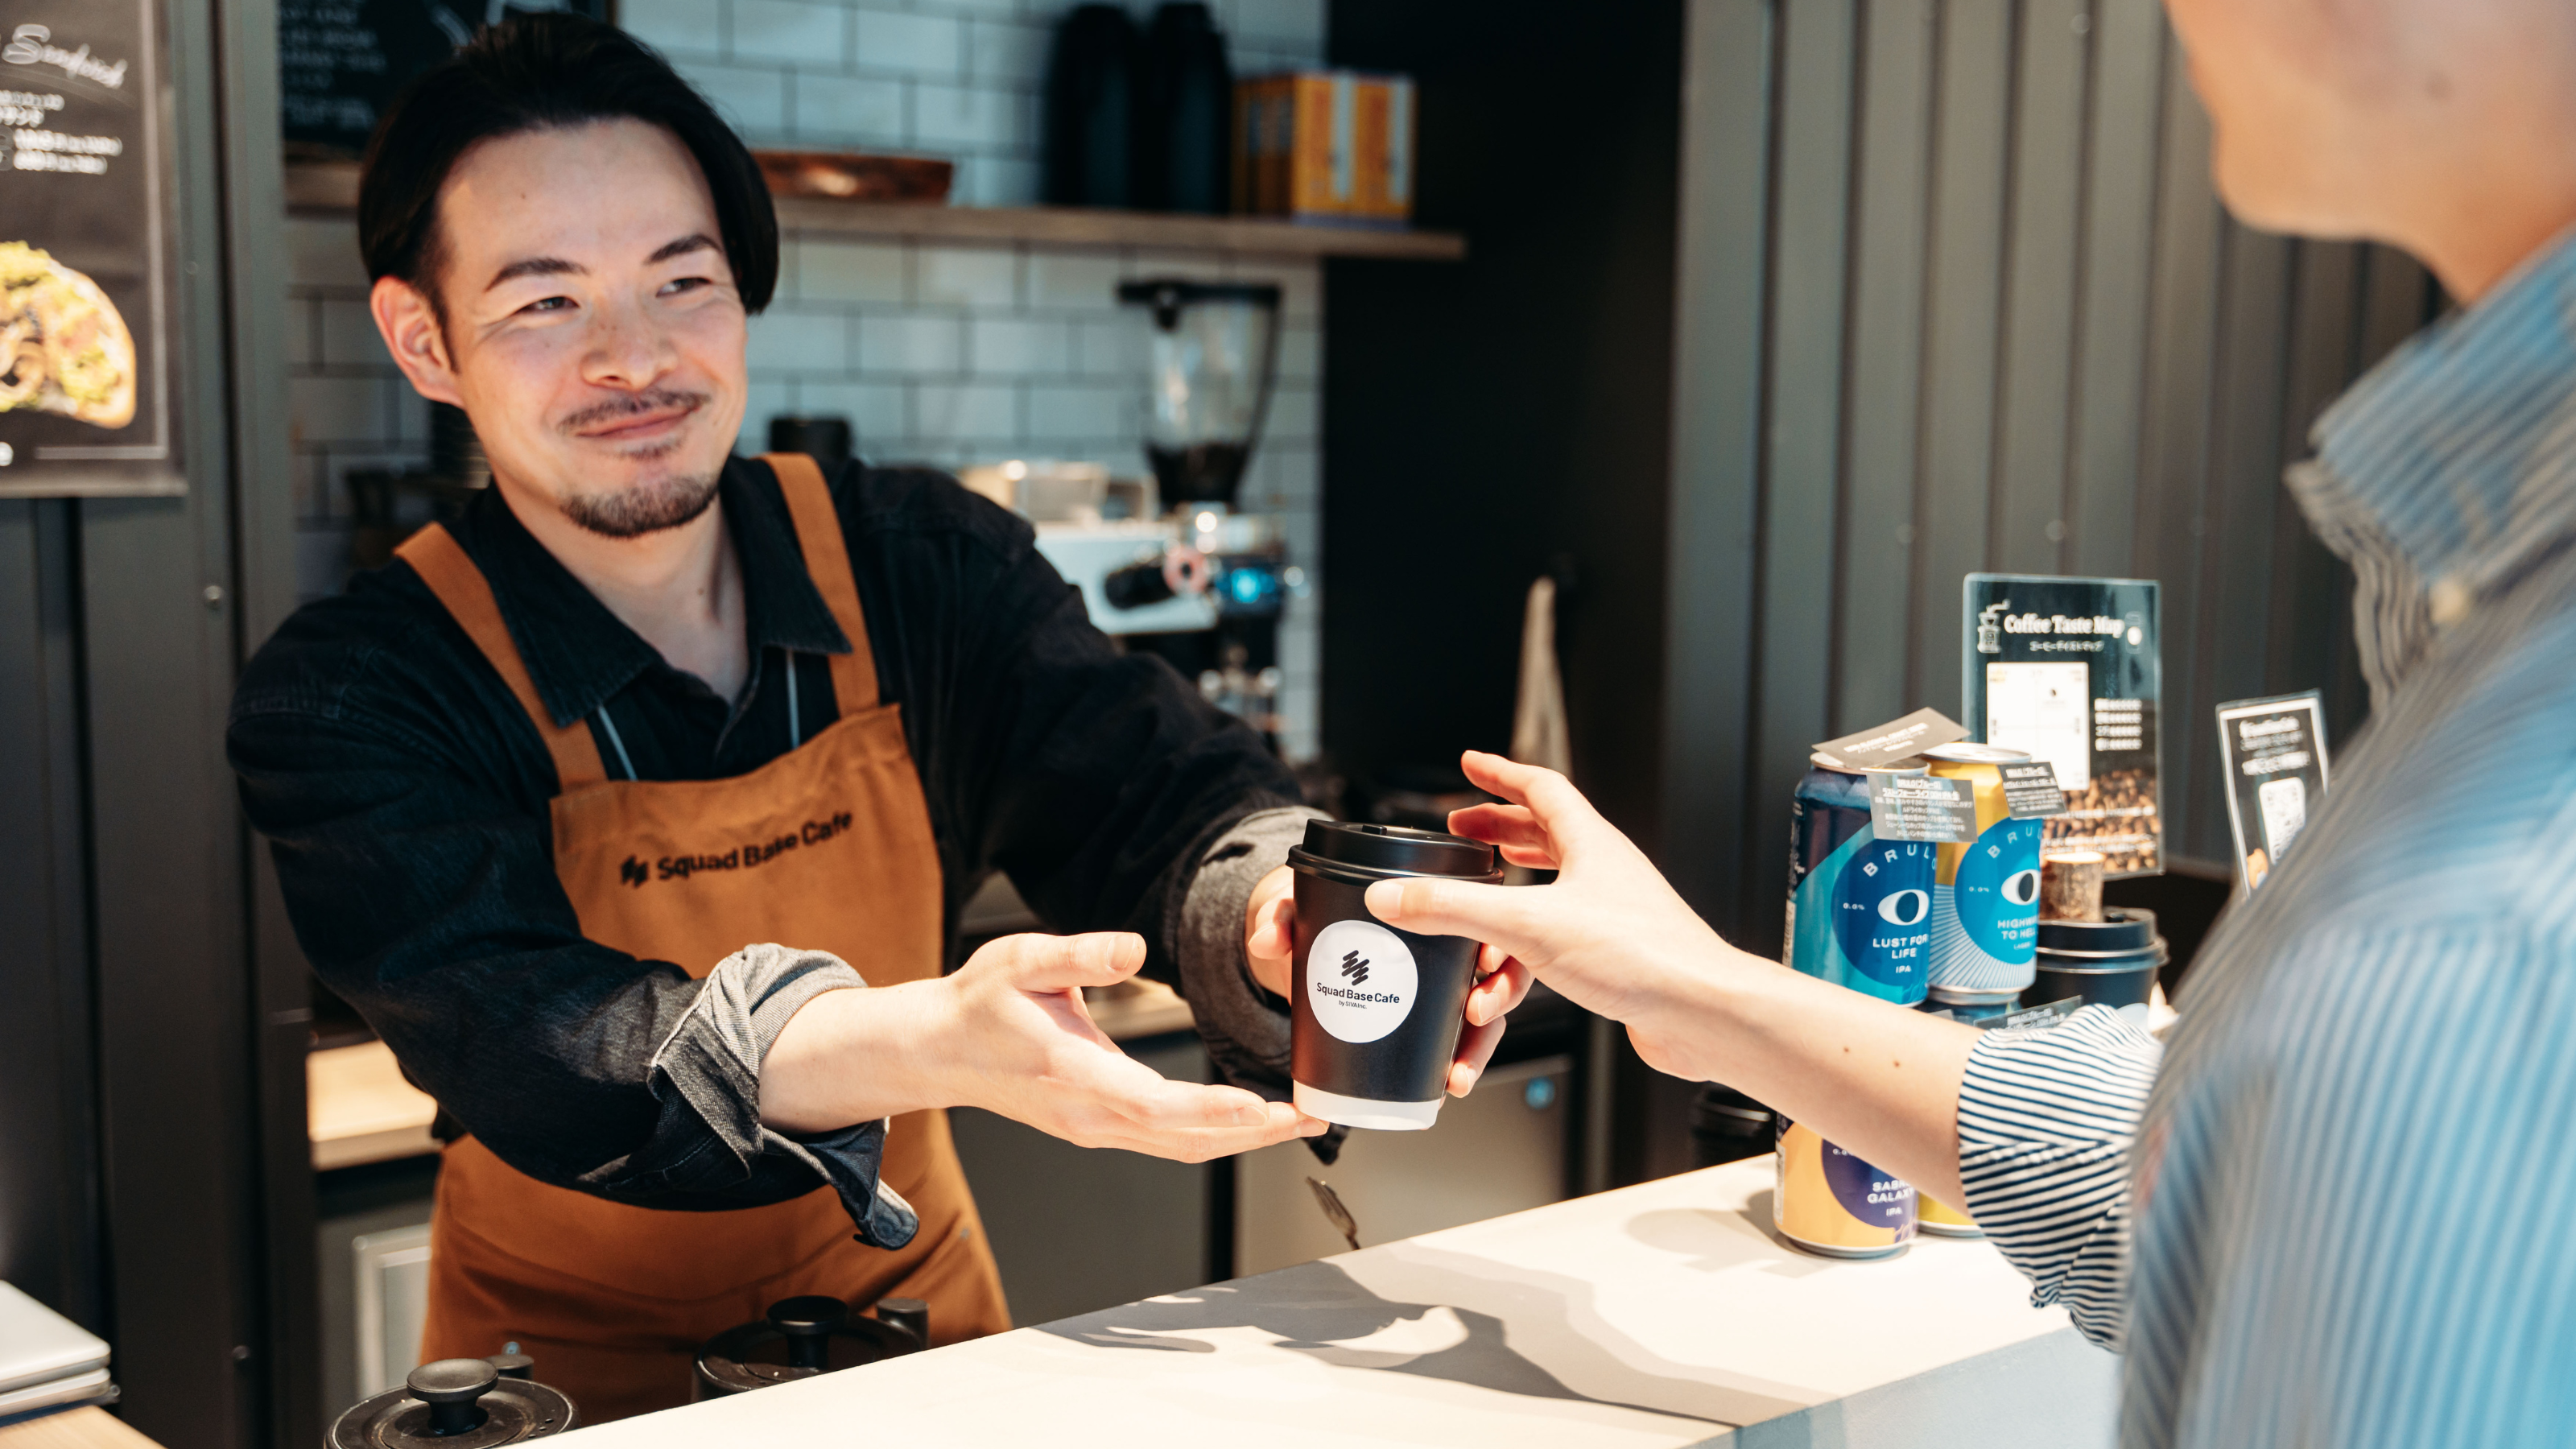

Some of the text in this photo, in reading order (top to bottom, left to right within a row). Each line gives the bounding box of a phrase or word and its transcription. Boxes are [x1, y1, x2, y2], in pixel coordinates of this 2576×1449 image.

[2004, 613, 2125, 638] Coffee Taste Map
[658, 848, 738, 880] Squad
[801, 811, 852, 846] Cafe
[1843, 902, 1865, 910] 0.0%
[1872, 933, 1929, 948] LUST FOR
[2001, 930, 2018, 940] TO
[1892, 947, 1917, 959] LIFE
[1896, 965, 1912, 973] IPA
[1317, 982, 1400, 1003] Squad Base Cafe
[1833, 1148, 1853, 1156] 0.0
[1867, 1187, 1914, 1203] GALAXY
[1886, 1207, 1903, 1217] IPA
